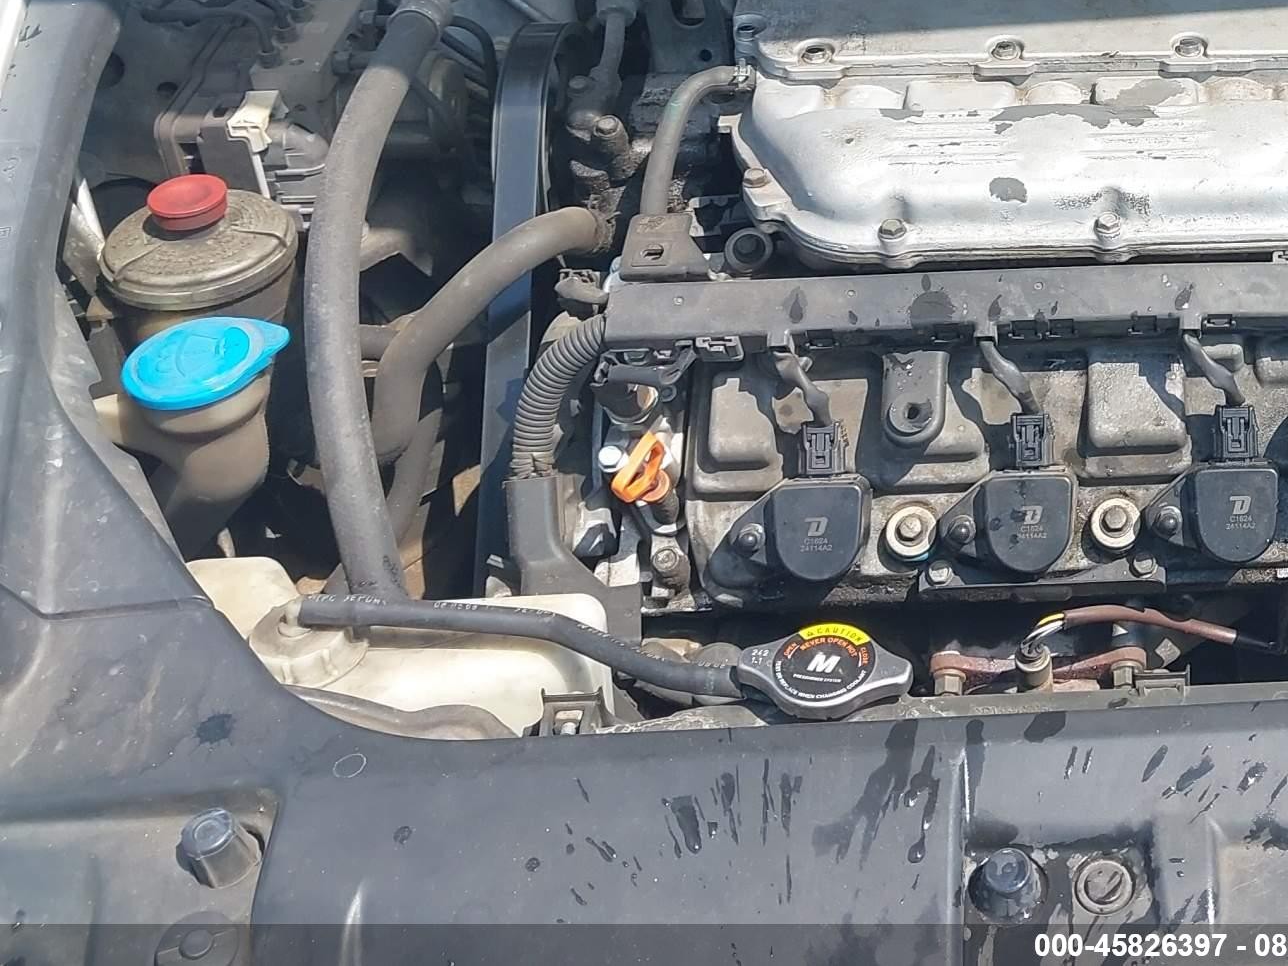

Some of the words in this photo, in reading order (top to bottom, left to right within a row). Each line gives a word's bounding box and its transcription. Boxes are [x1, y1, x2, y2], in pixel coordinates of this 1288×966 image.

[816, 627, 866, 643] CAUTION
[800, 637, 827, 651] NEVER
[827, 637, 849, 649] OPEN
[846, 642, 858, 658] HOT
[807, 651, 842, 673] M
